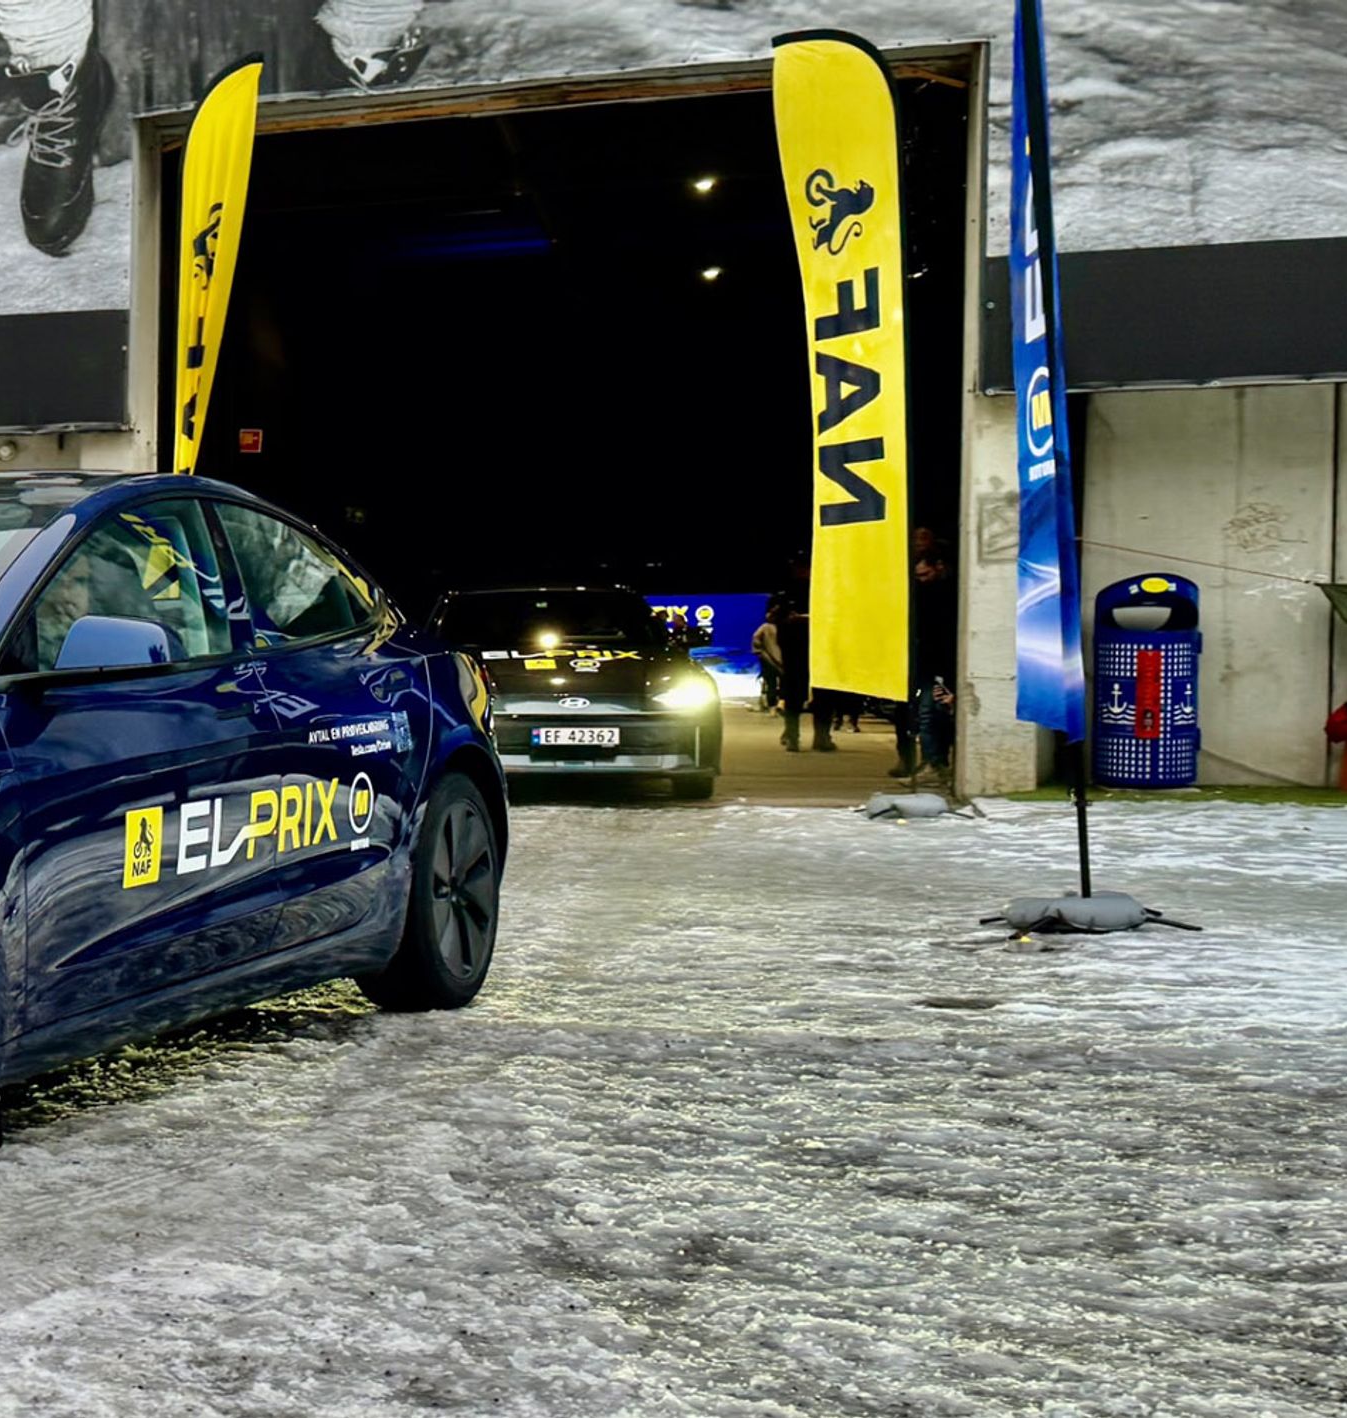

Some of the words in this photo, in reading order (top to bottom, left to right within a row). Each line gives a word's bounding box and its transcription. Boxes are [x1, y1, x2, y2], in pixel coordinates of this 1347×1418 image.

[308, 729, 330, 744] AVTAL
[330, 727, 341, 740] EN
[544, 730, 561, 743] EF
[568, 730, 615, 743] 42362
[131, 858, 152, 877] NAF
